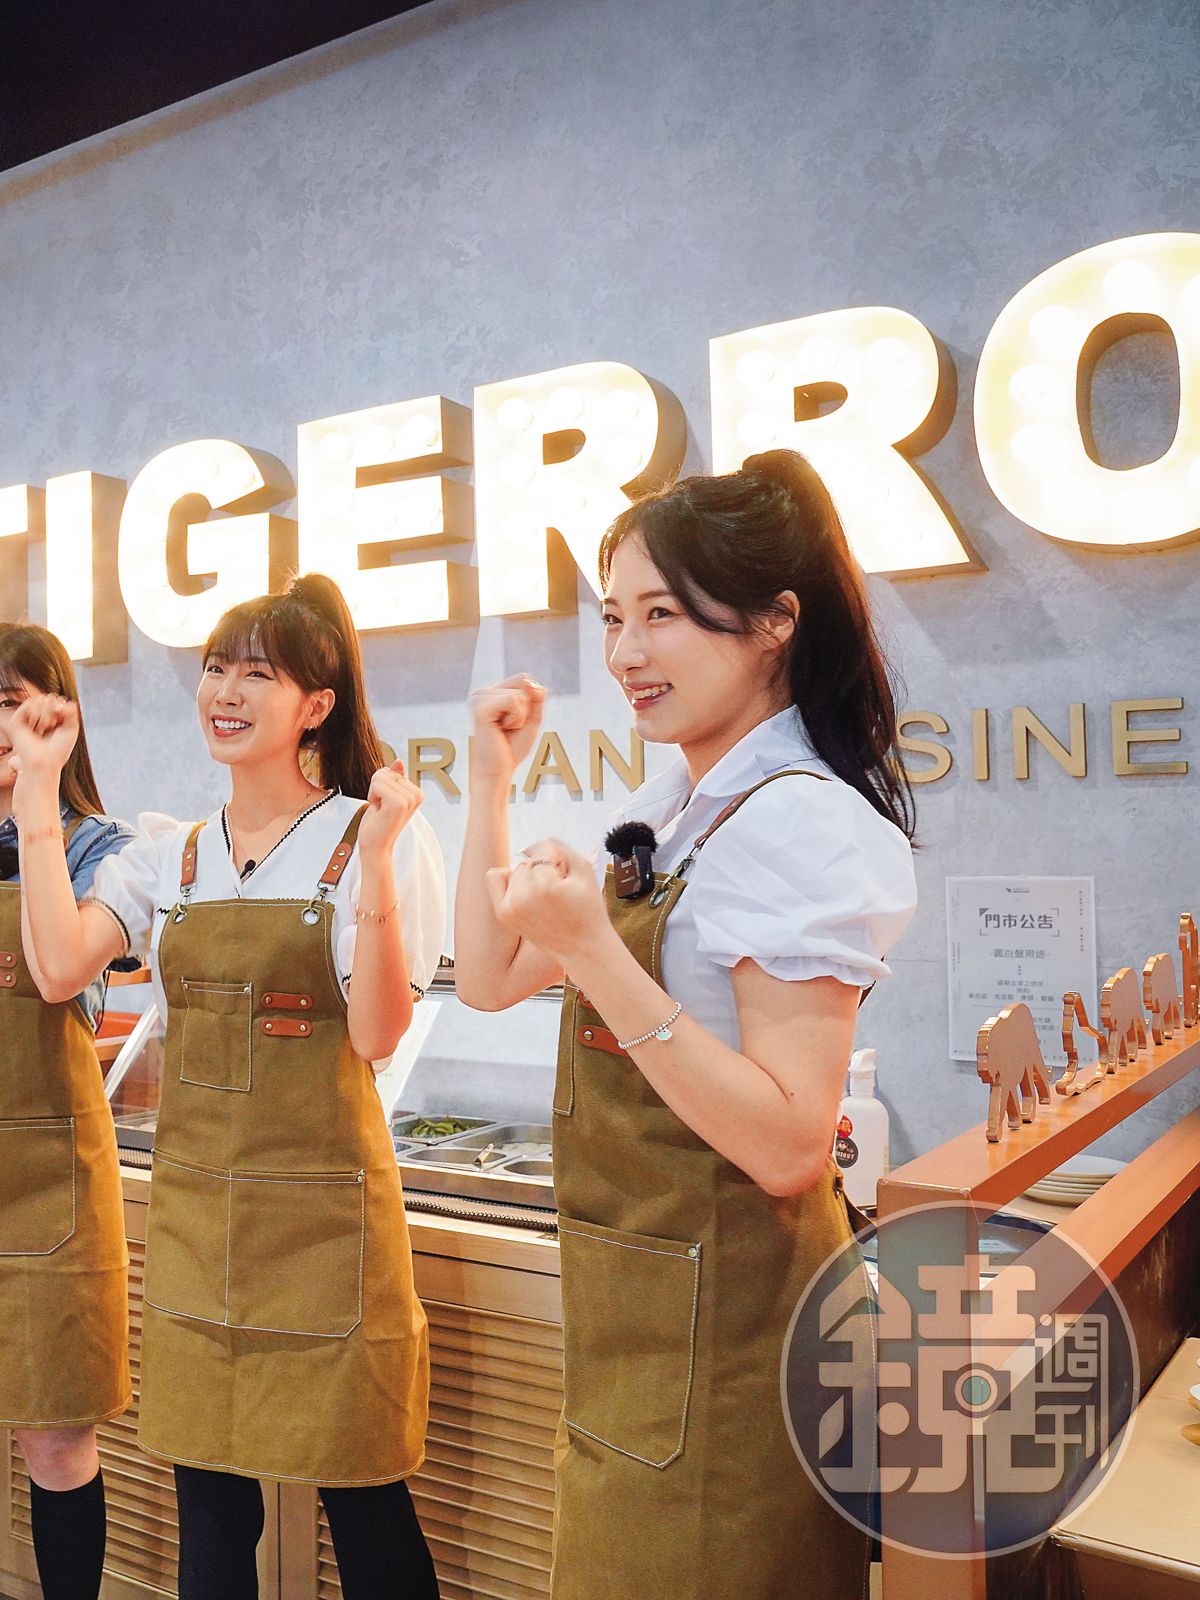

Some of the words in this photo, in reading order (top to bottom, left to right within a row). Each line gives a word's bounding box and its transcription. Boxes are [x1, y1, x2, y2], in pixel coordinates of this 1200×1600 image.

[298, 727, 647, 799] RAN
[888, 696, 1189, 785] SINE
[985, 913, 1053, 929] 門市公告
